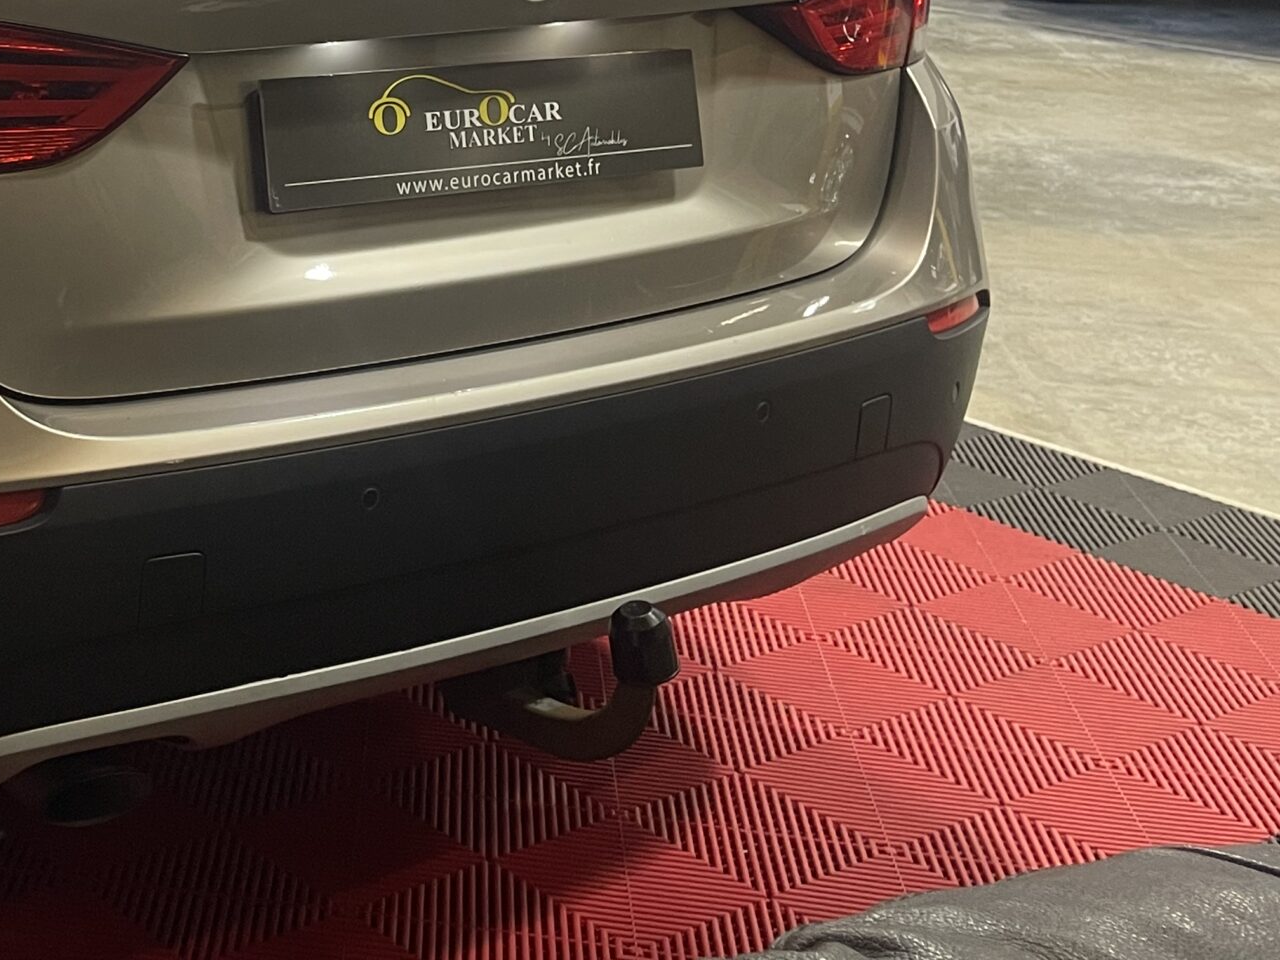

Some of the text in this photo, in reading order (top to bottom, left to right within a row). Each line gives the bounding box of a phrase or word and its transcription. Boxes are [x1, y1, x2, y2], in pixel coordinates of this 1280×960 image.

[425, 95, 562, 132] EUROCAR
[449, 124, 538, 150] MARKET
[396, 158, 600, 195] www.eurocarmarket.fr
